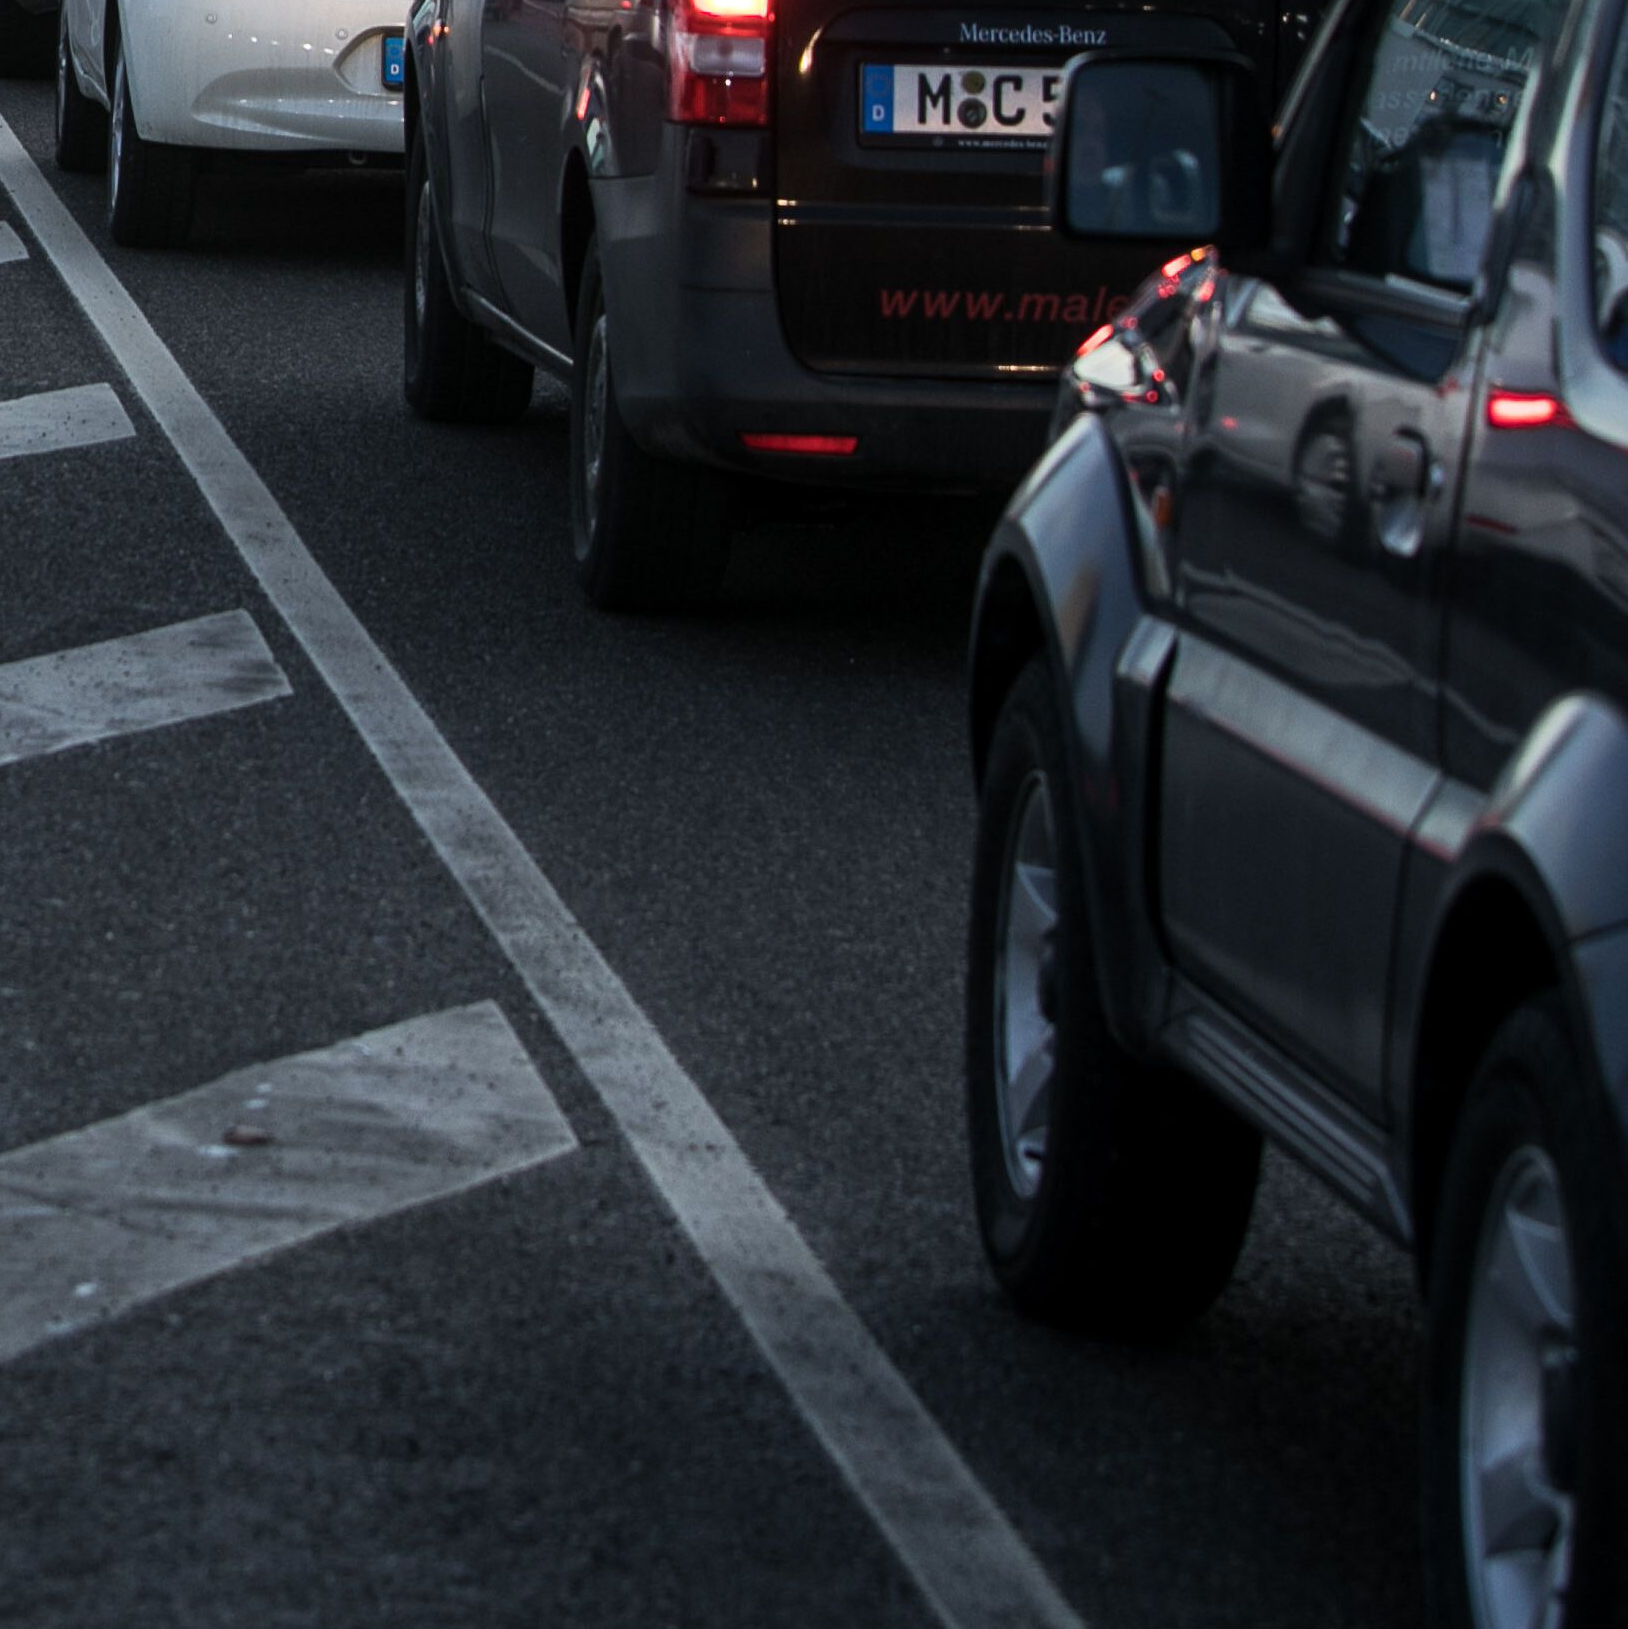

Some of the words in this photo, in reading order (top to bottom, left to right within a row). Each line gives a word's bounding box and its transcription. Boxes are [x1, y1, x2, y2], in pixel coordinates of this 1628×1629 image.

[959, 22, 1107, 46] Mercedes-Benz
[390, 64, 399, 75] D
[872, 104, 885, 122] D
[917, 73, 951, 125] M
[992, 75, 1026, 127] C
